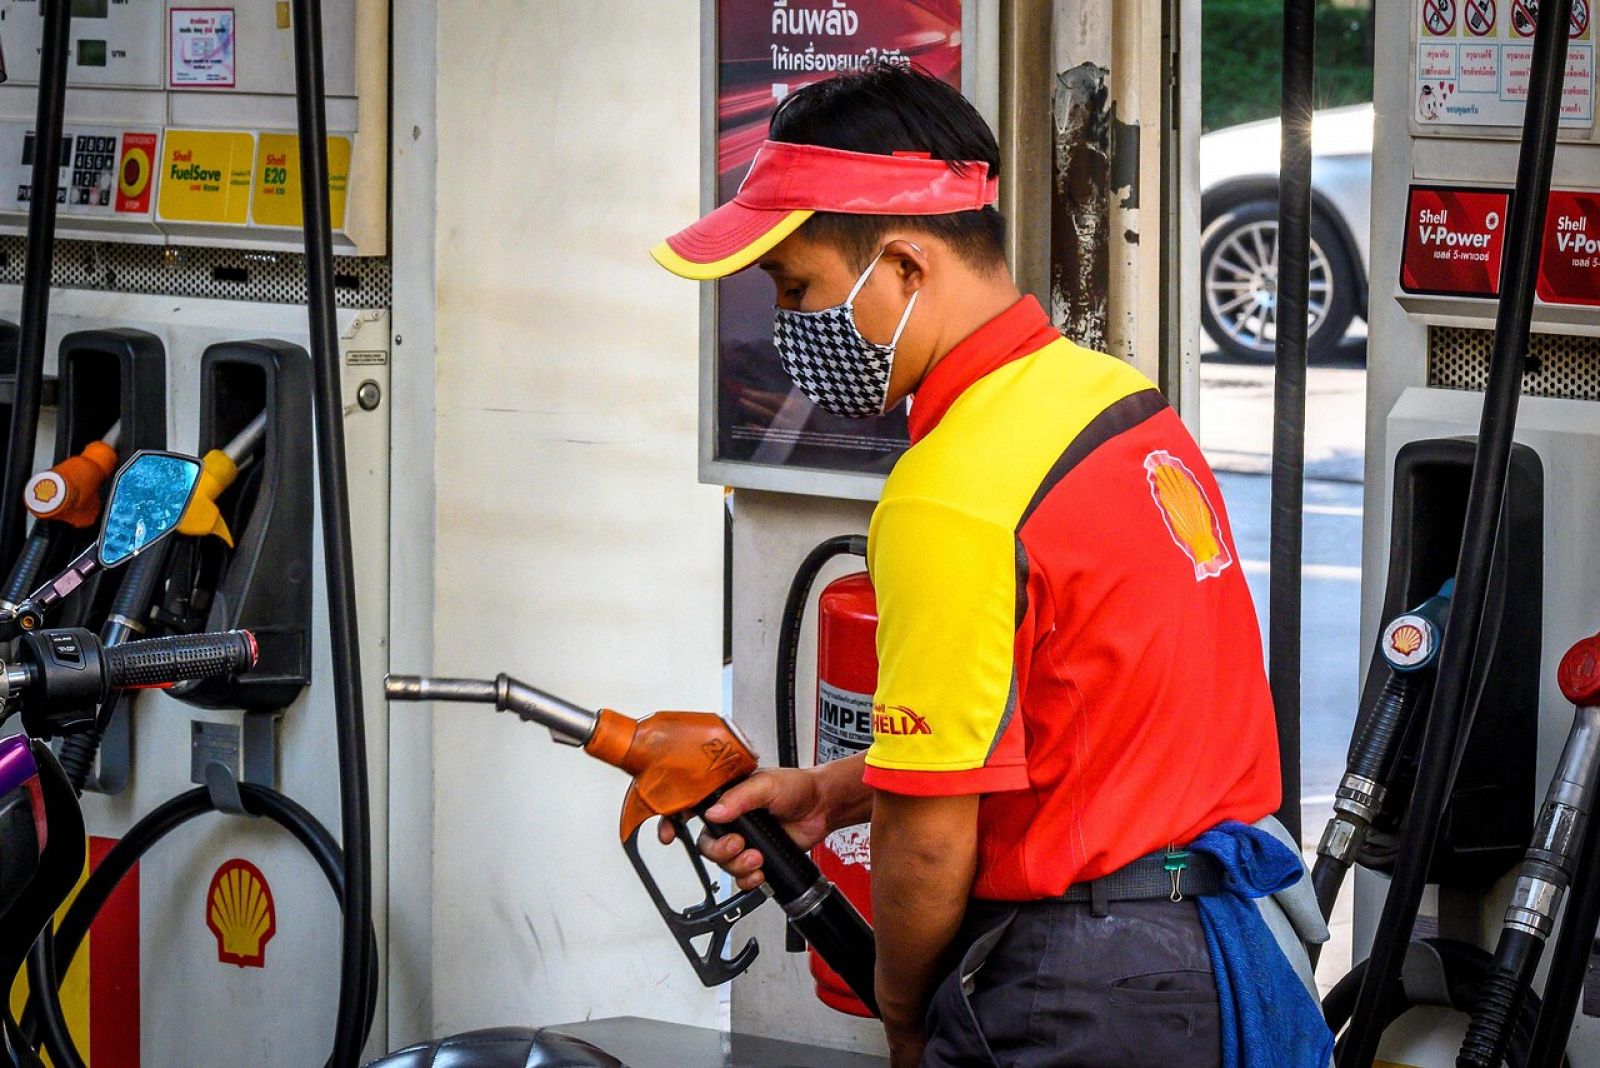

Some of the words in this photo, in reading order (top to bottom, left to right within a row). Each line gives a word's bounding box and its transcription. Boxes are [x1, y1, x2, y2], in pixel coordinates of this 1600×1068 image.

[172, 150, 192, 162] Shell
[266, 153, 286, 166] Shell
[170, 164, 221, 181] FuelSave
[264, 168, 286, 185] E20
[1419, 209, 1447, 224] Shell
[1557, 216, 1586, 231] Shell
[1419, 225, 1491, 248] V-Power
[872, 705, 932, 735] HELIX
